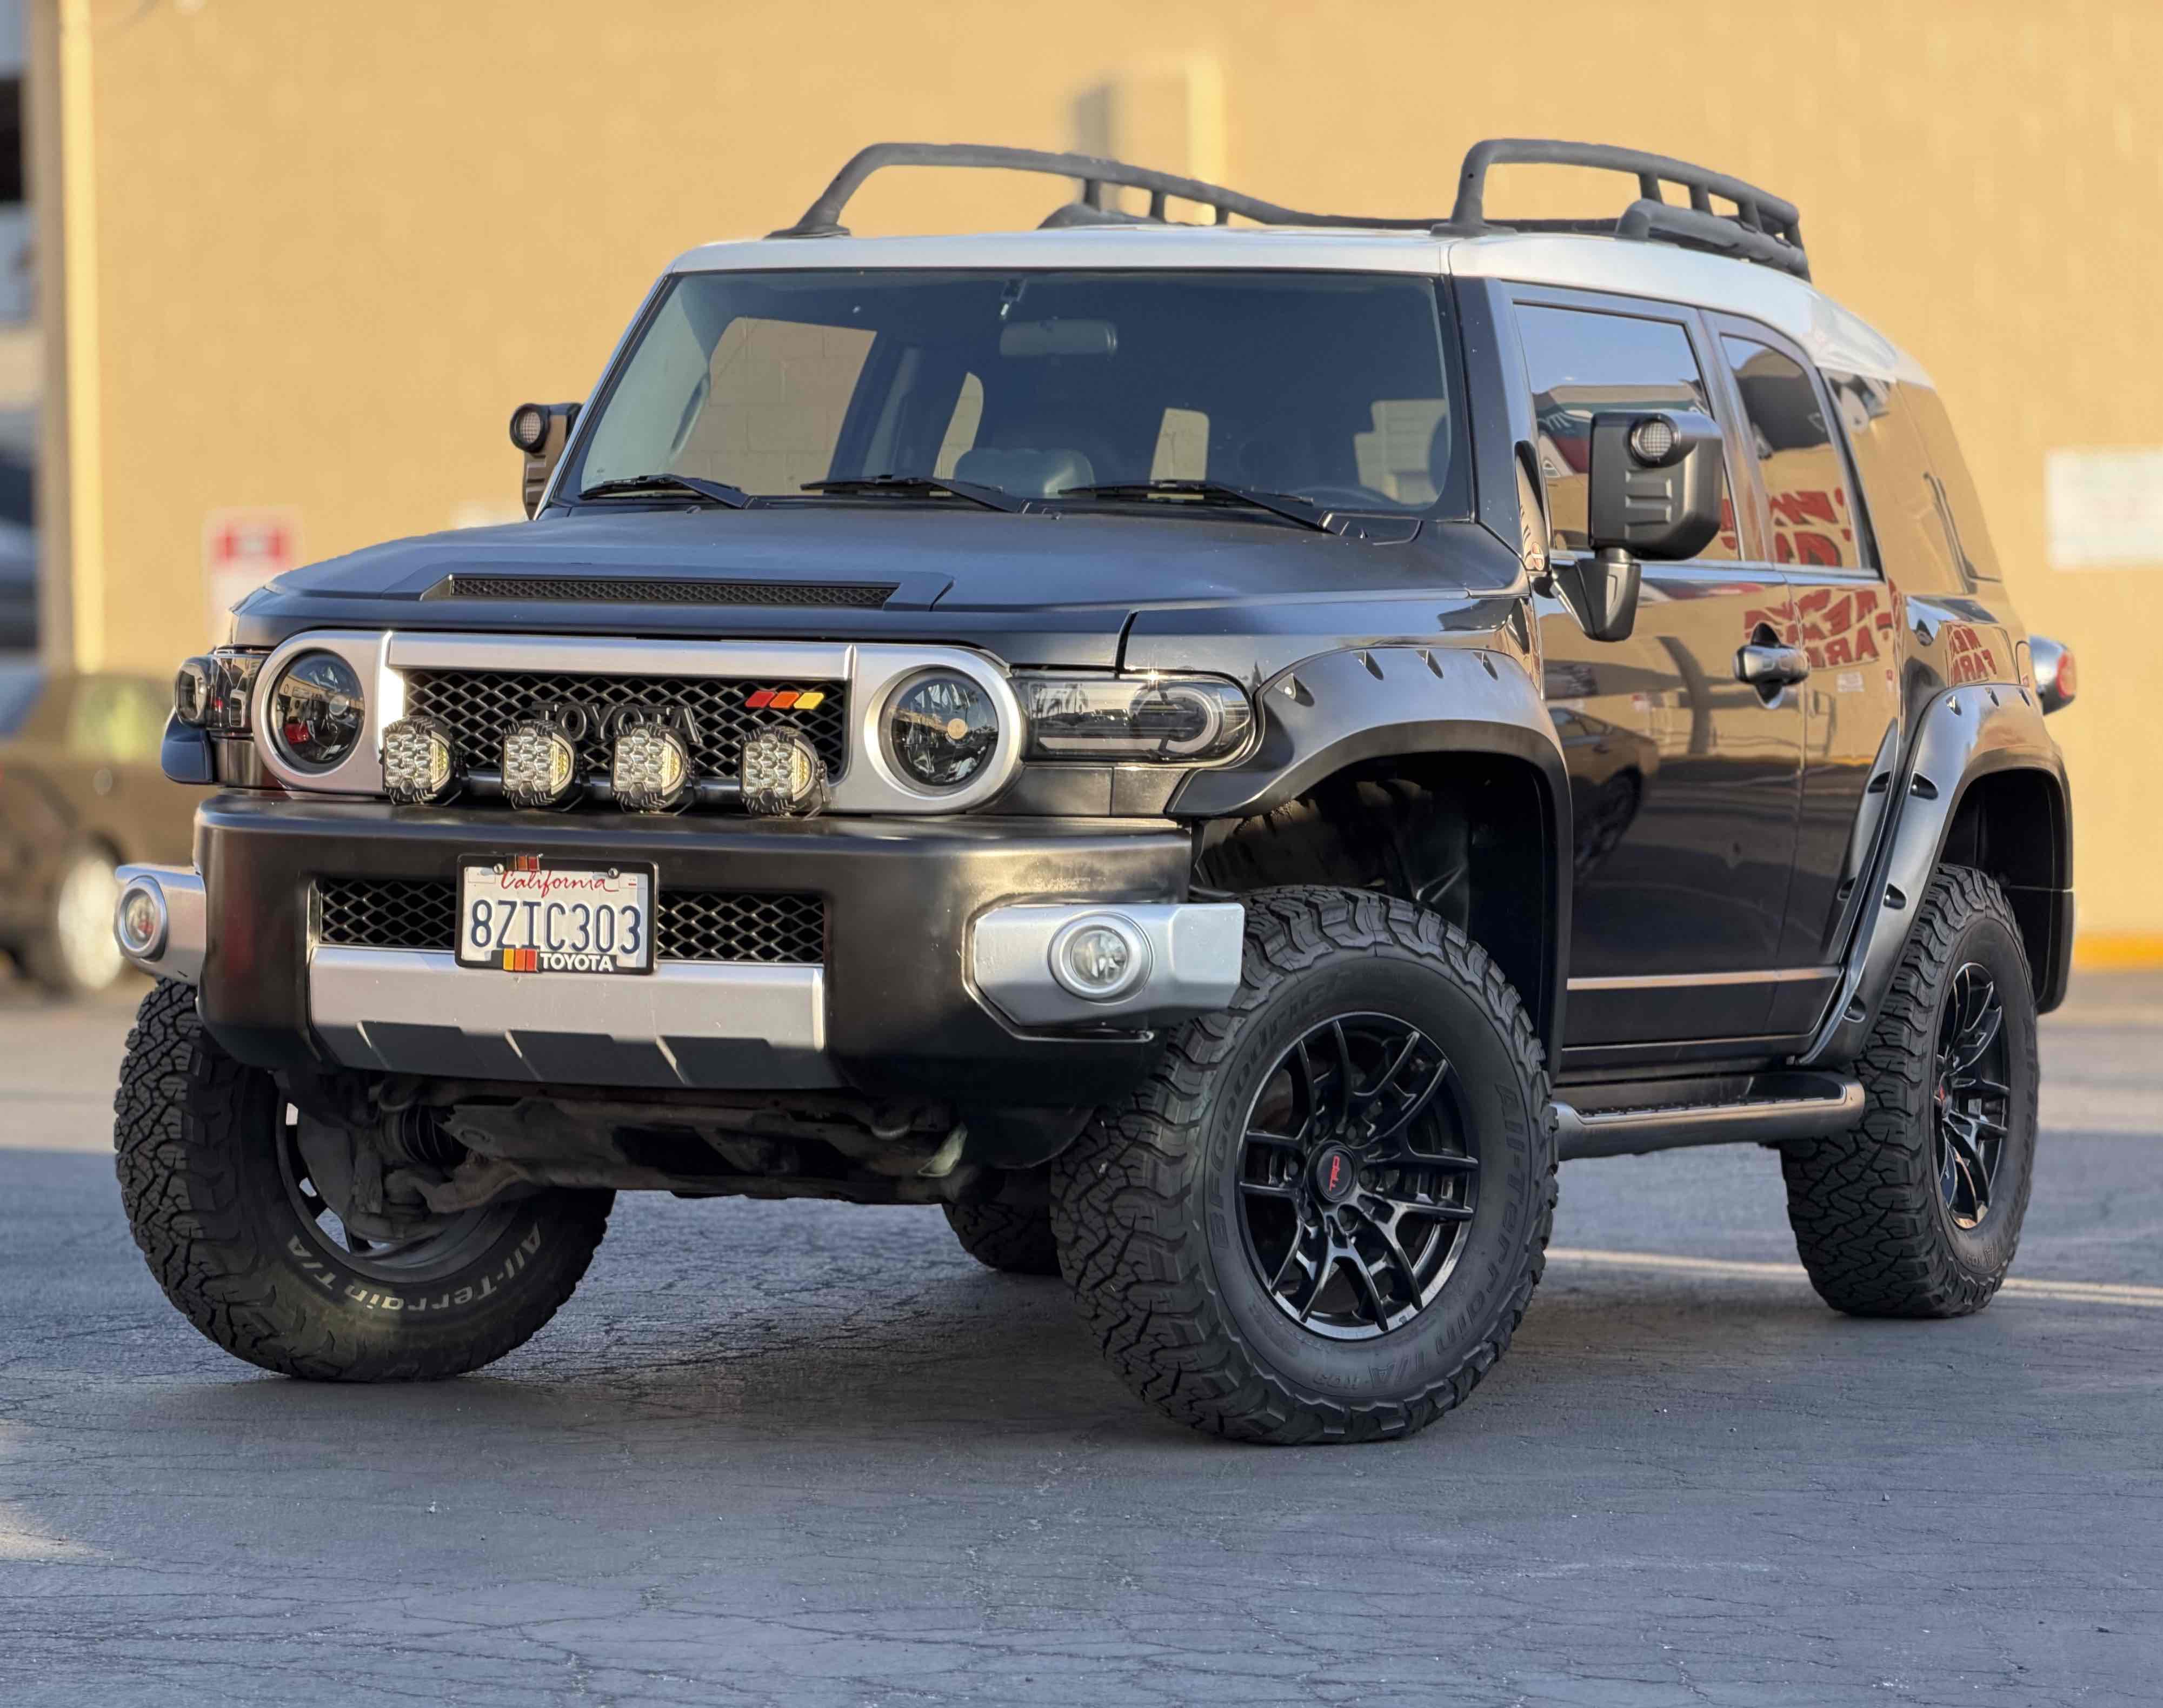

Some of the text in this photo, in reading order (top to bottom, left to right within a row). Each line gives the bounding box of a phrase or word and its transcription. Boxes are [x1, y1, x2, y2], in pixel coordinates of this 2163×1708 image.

[501, 868, 619, 898] California
[470, 899, 641, 954] 8ZIC303
[540, 952, 614, 972] TOYOTA
[288, 1221, 541, 1312] All-Terrain T/A
